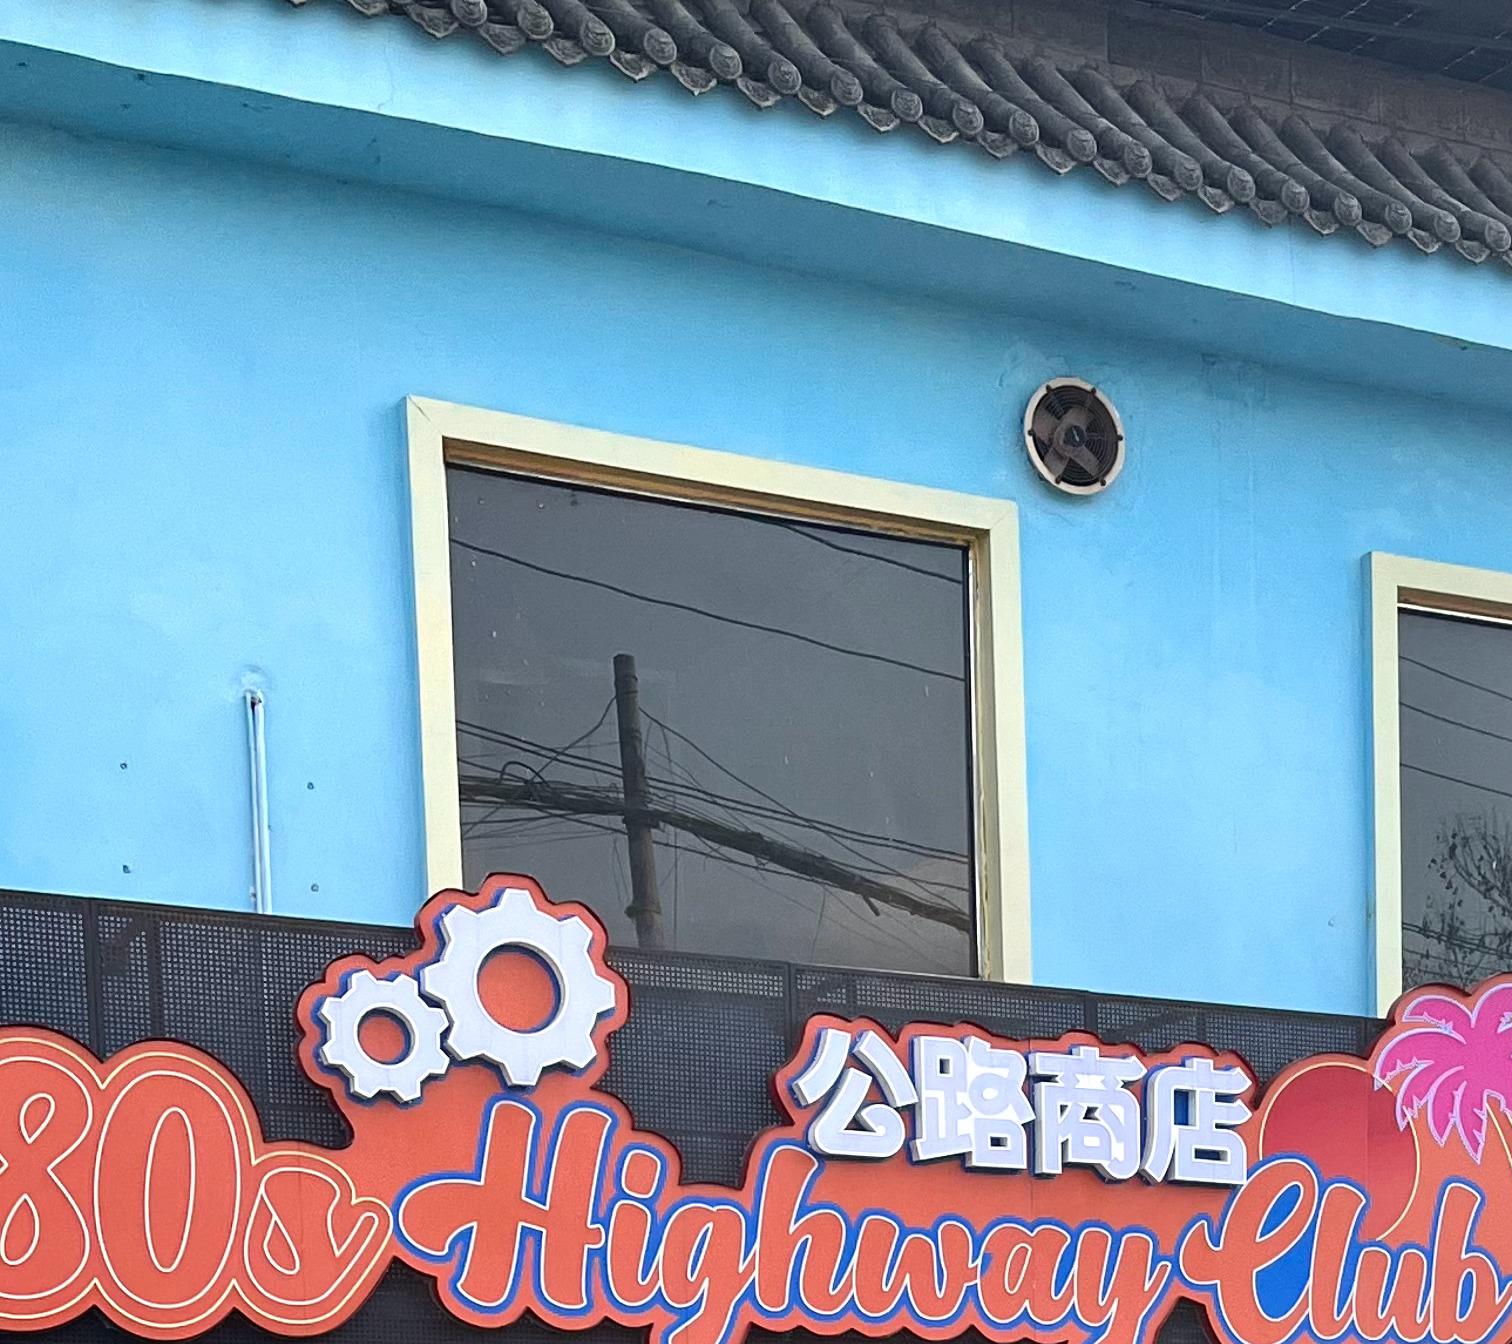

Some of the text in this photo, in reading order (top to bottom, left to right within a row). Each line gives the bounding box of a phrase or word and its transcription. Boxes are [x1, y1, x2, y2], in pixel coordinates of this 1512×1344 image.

[0, 1045, 395, 1315] 80s
[794, 1026, 1258, 1187] 公路商店
